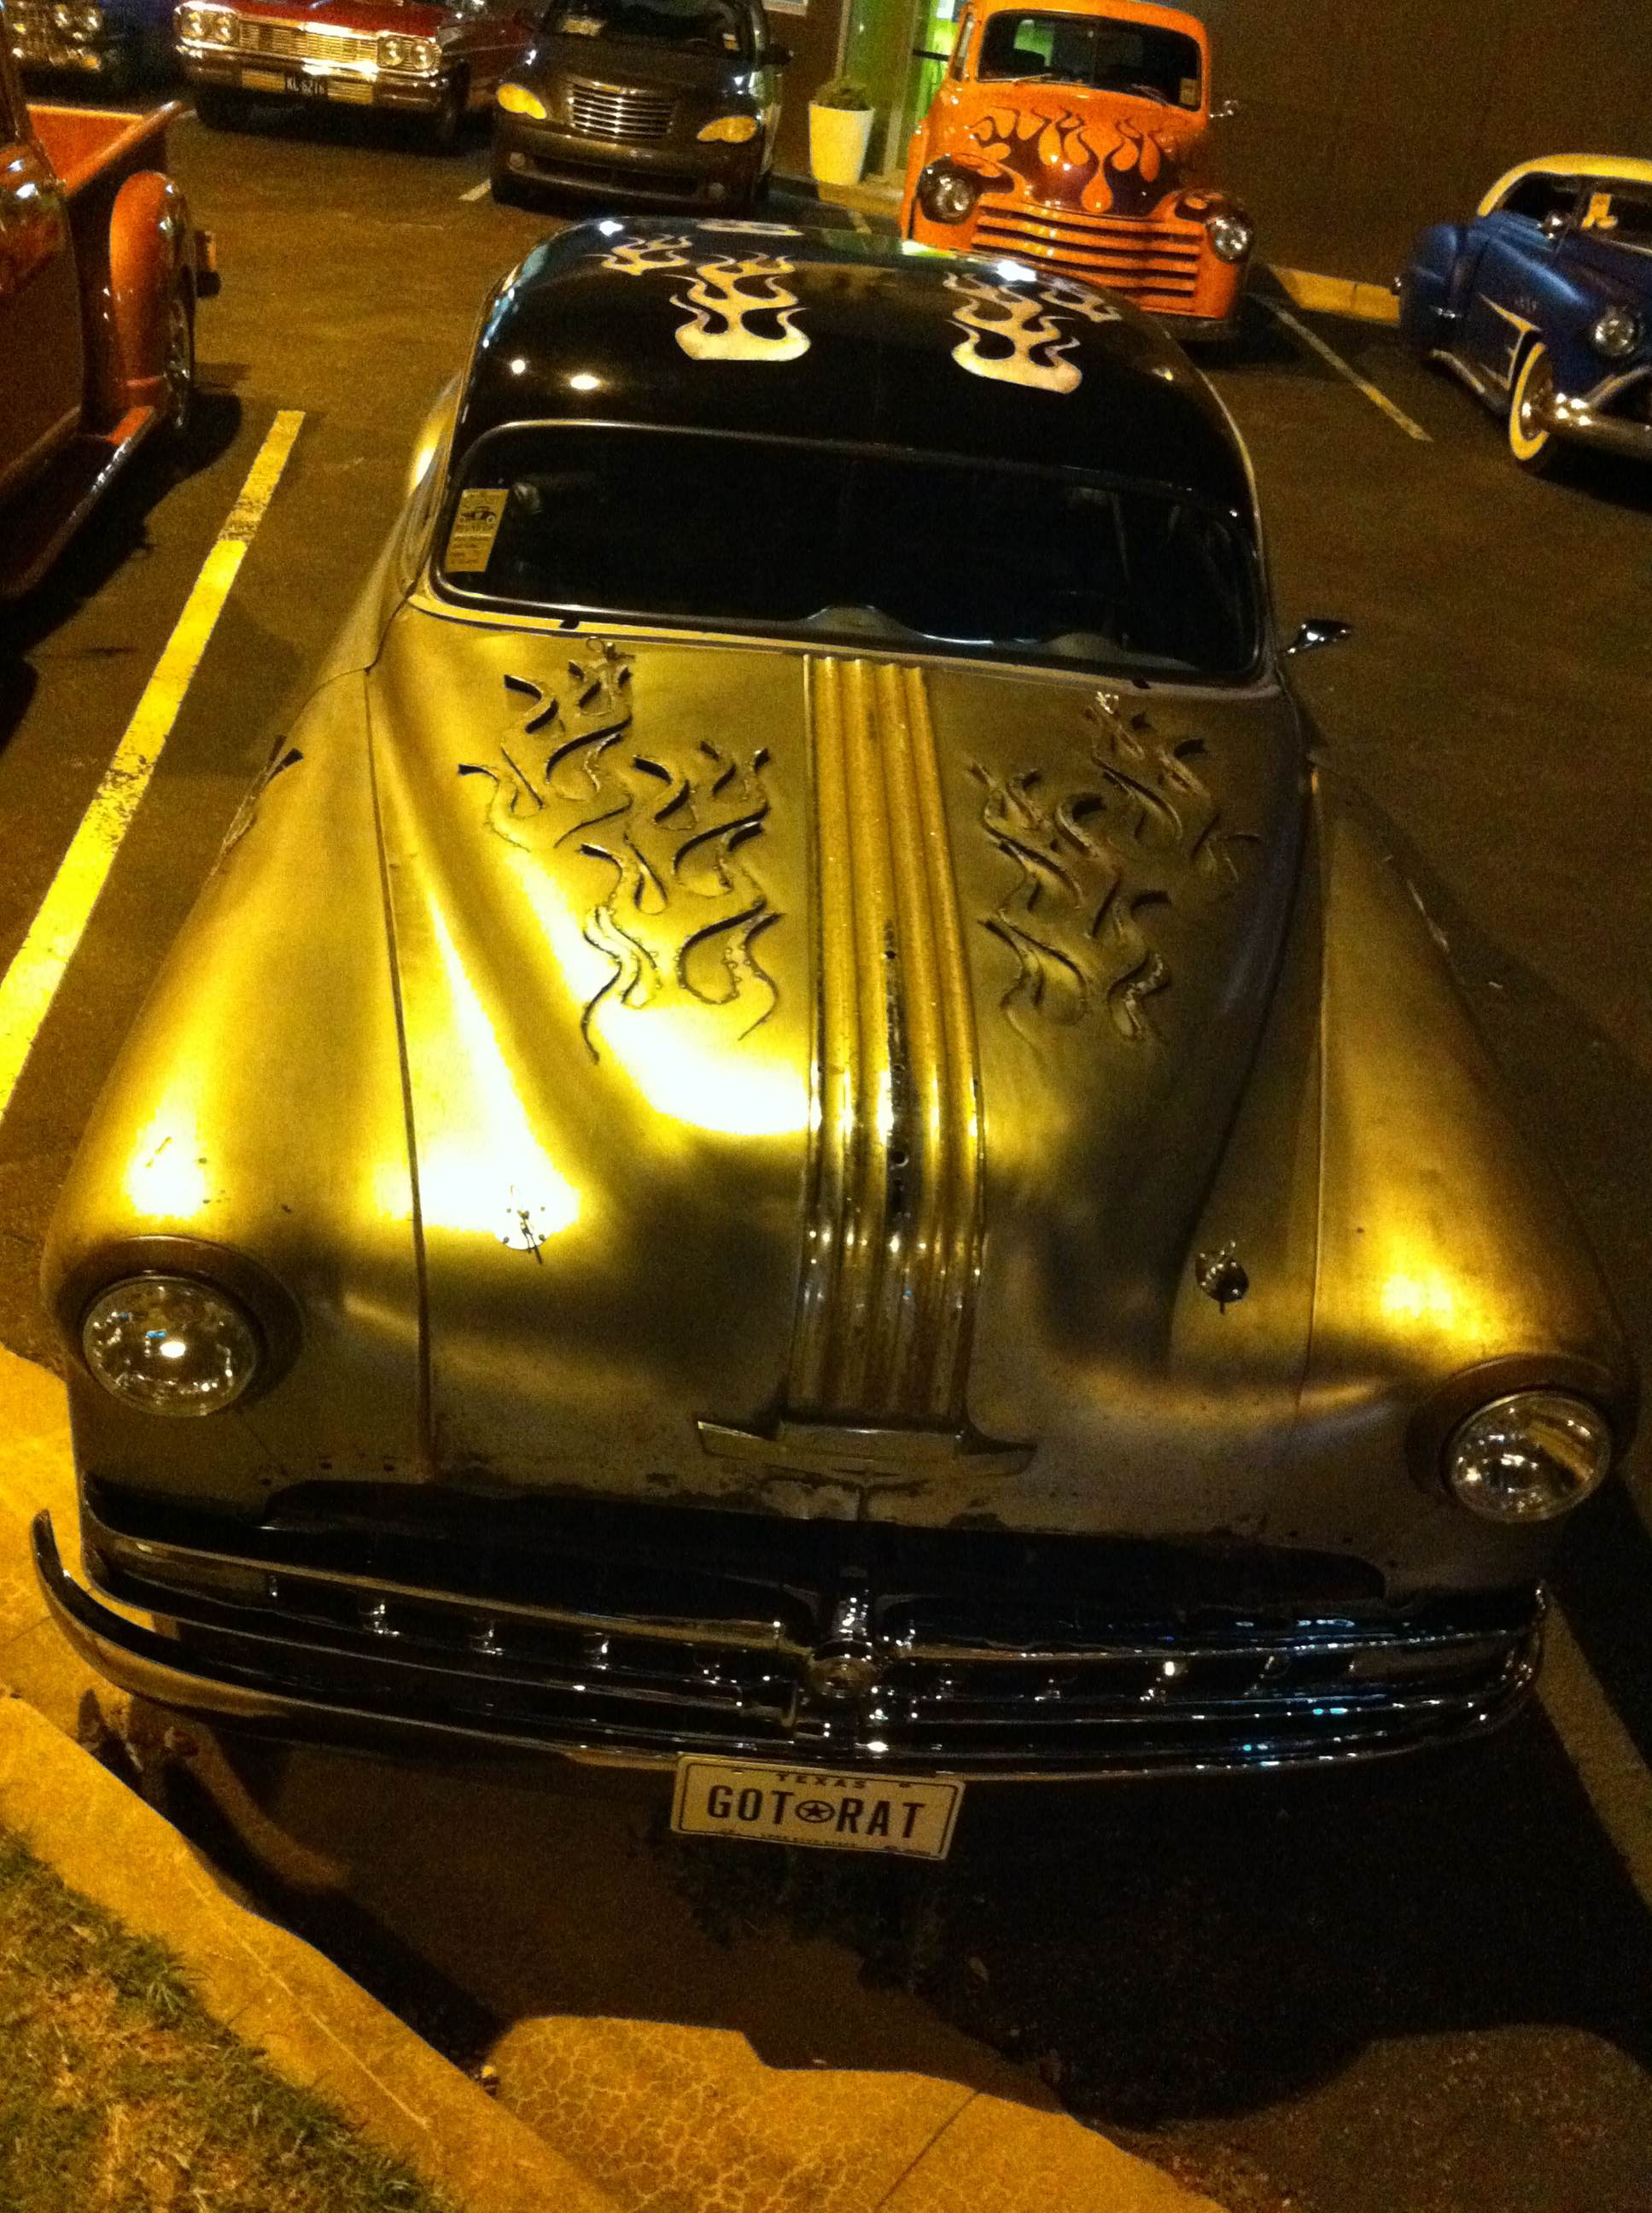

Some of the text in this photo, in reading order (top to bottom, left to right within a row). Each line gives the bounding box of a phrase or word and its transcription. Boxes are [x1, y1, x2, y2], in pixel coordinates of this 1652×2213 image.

[777, 1771, 867, 1790] TEXAS
[707, 1784, 925, 1838] GOT RAT
